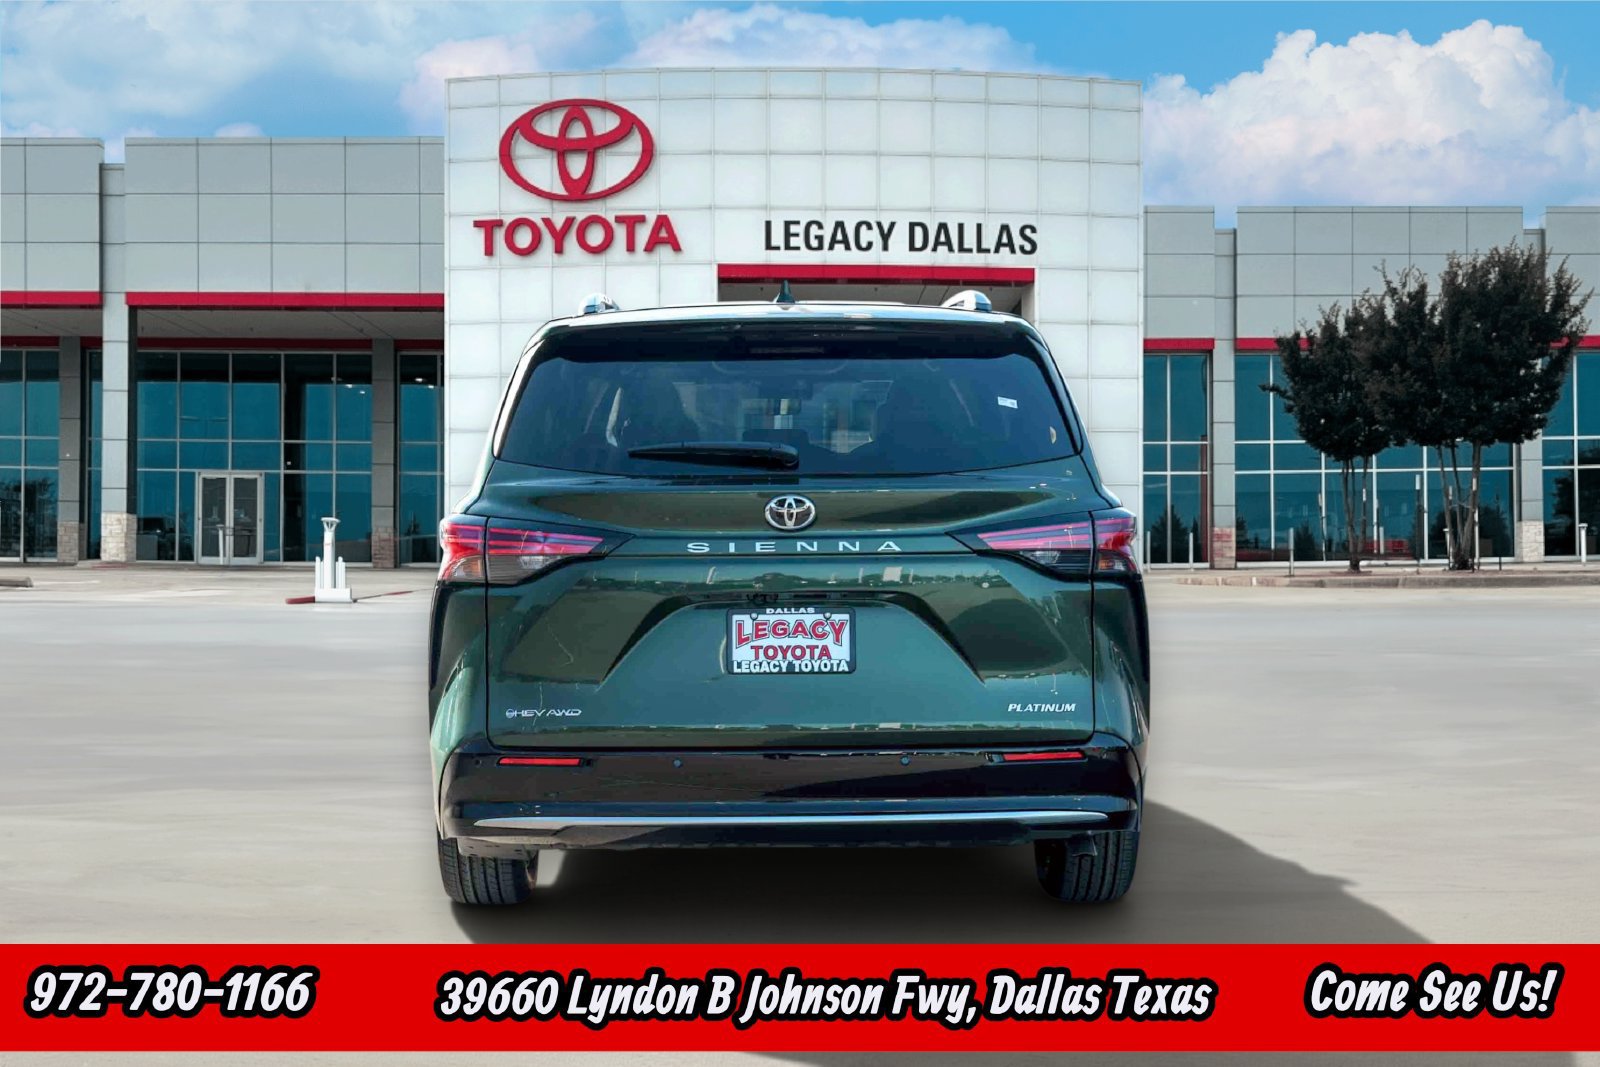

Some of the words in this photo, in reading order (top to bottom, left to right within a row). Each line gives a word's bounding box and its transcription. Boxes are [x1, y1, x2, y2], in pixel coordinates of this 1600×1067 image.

[473, 214, 682, 256] TOYOTA
[765, 220, 896, 251] LEGACY
[908, 221, 1038, 255] DALLAS
[686, 541, 902, 553] SIENNA
[765, 607, 816, 615] DALLAS
[736, 620, 848, 649] LEGACY
[750, 645, 833, 660] TOYOTA
[733, 660, 789, 673] LEGACY
[793, 660, 849, 673] TOYOTA
[546, 708, 582, 717] AWD
[1007, 703, 1077, 713] PLATINUM
